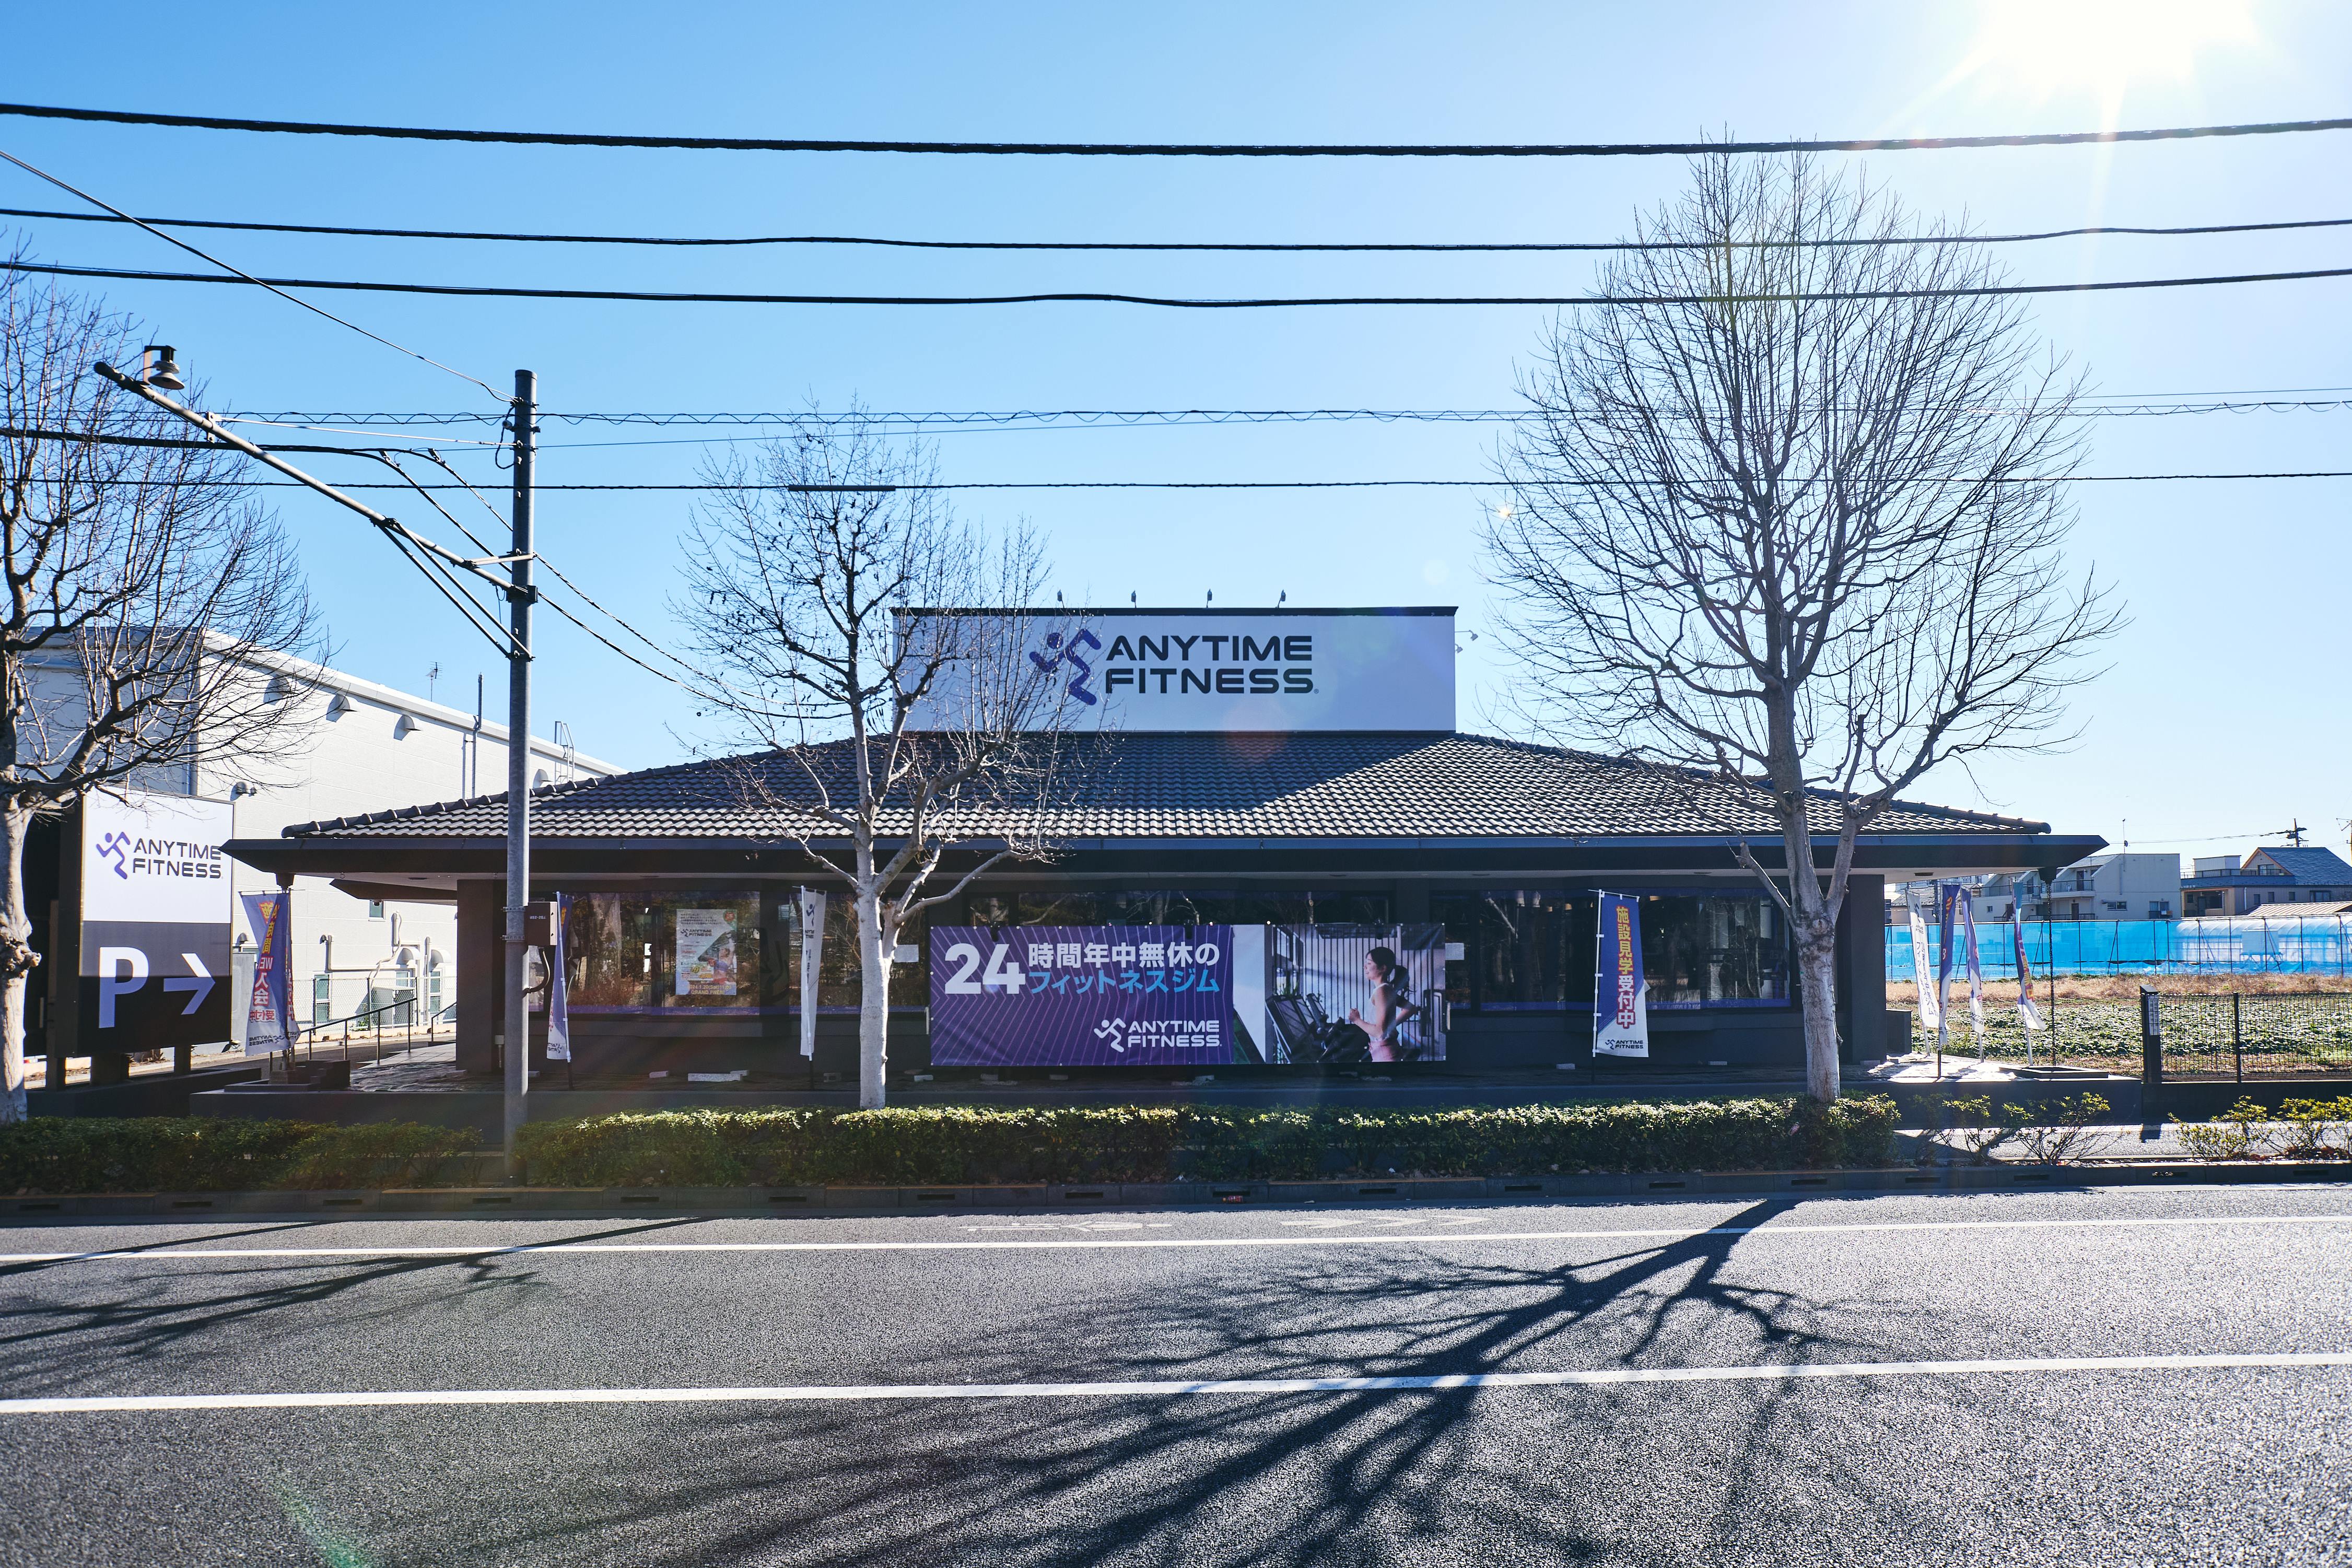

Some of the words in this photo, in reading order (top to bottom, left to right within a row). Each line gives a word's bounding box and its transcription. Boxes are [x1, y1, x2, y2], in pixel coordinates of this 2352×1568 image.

[1106, 635, 1312, 661] ANYTIME
[1105, 668, 1314, 694] FITNESS
[134, 838, 221, 860] ANYTIME
[133, 858, 221, 879] FITNESS
[944, 943, 1026, 994] 24
[1028, 942, 1220, 968] 時間年中無休の
[1616, 906, 1634, 1028] 施設見学受付中
[99, 946, 149, 1028] P
[1028, 969, 1220, 994] フィットネスジム
[1128, 1020, 1220, 1033] ANYTIME
[1127, 1035, 1220, 1047] FITNESS
